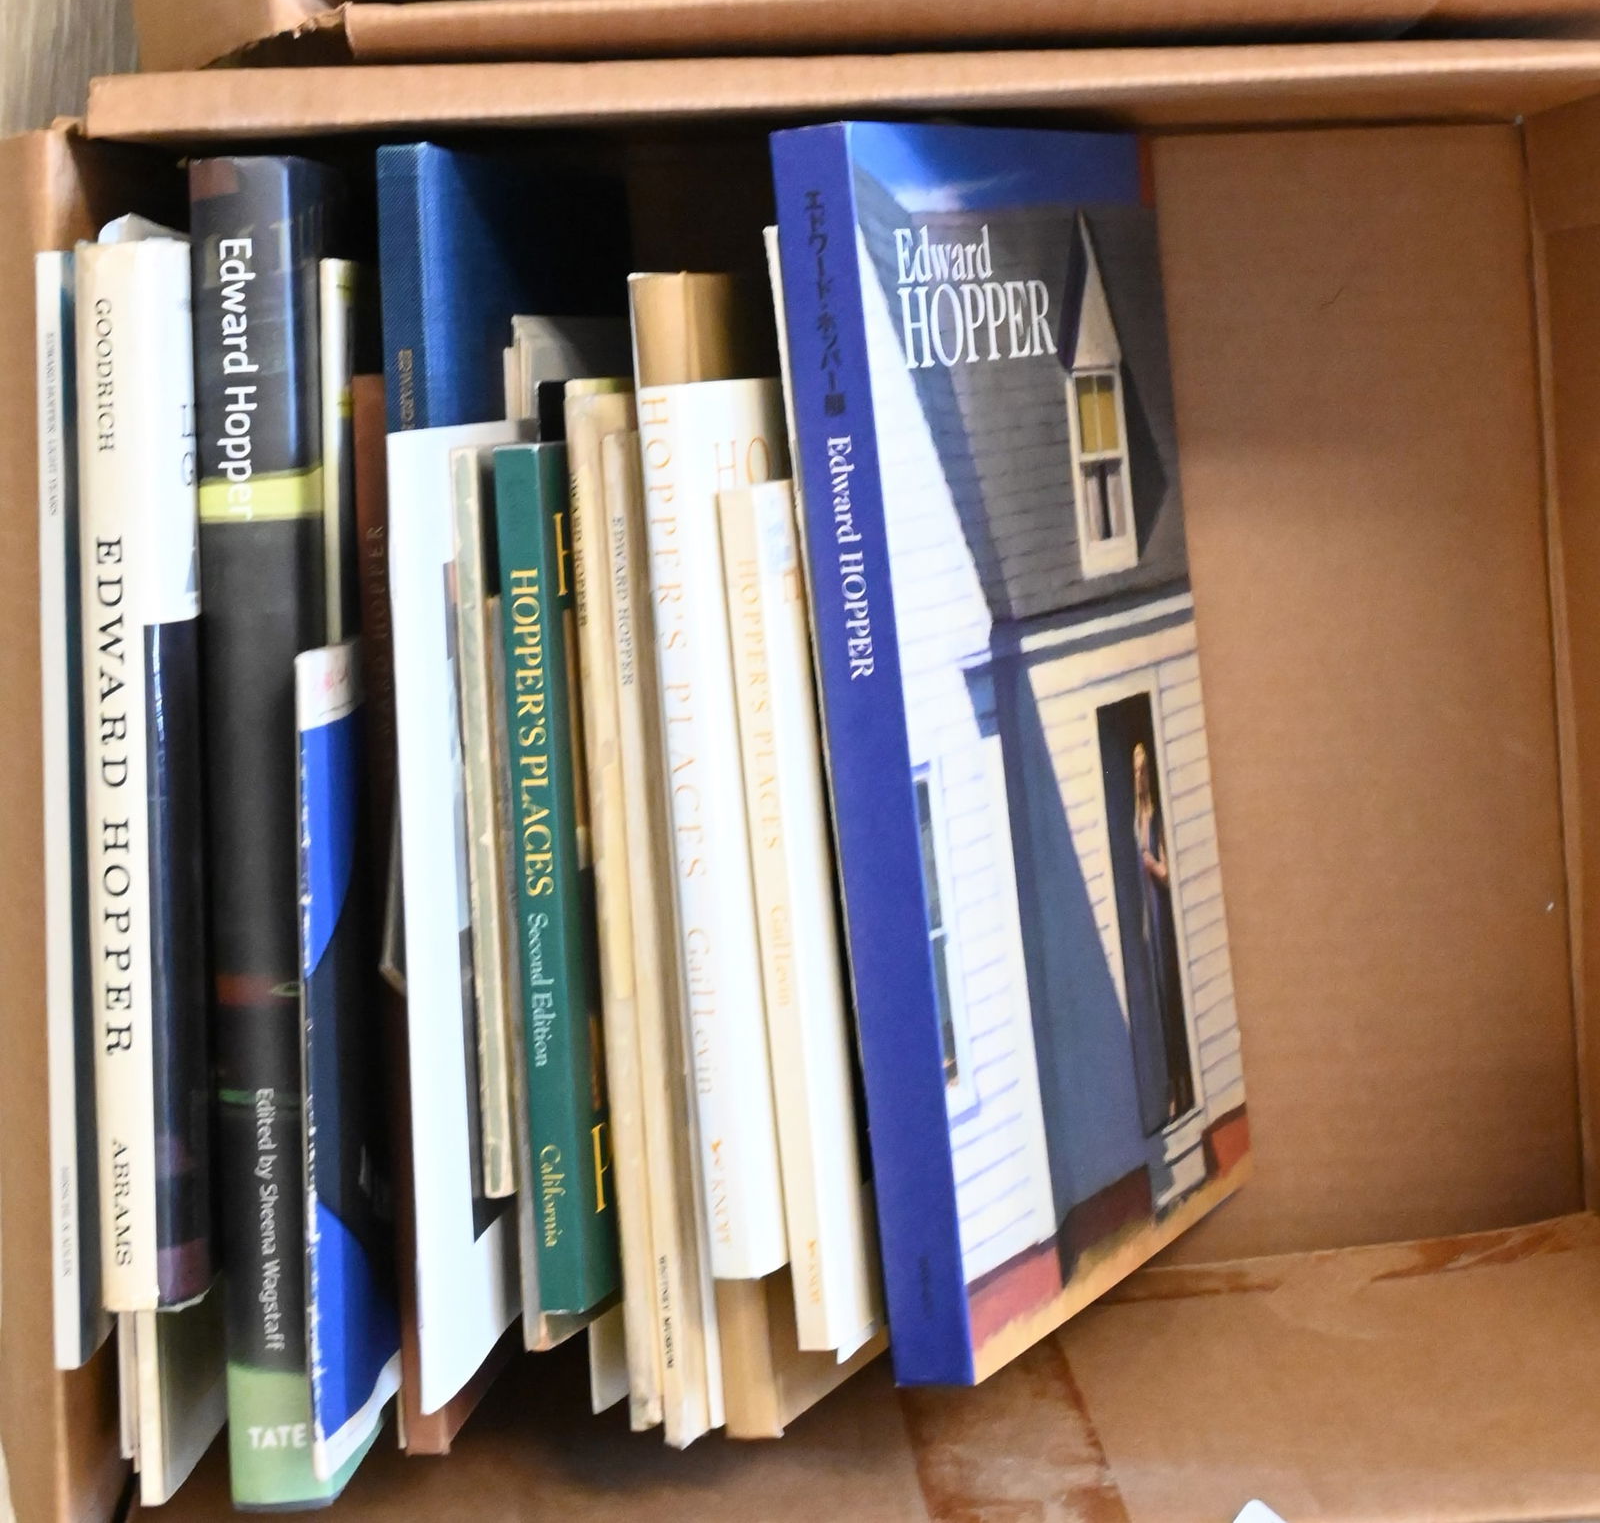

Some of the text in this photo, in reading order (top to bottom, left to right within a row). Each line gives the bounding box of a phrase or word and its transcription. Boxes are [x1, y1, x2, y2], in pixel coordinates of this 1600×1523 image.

[804, 189, 847, 418] エドワード・ホッパー展
[892, 224, 994, 284] Edward
[897, 278, 1058, 370] HOPPER
[94, 297, 115, 453] GOODRICH
[216, 237, 260, 520] Edward Hopper
[571, 548, 589, 627] HOPPER
[611, 515, 635, 686] EDWARD HOPPER
[640, 396, 708, 878] HOPPER'S PLACES
[826, 434, 875, 682] Edward HOPPER
[509, 567, 555, 898] HOPPER'S PLACES
[736, 558, 784, 850] HOPPER'S PLACES
[95, 536, 133, 1057] EDWARD HOPPER
[526, 911, 558, 1069] Second Edition
[687, 927, 716, 996] Gail
[111, 1138, 132, 1268] ABRAMS
[253, 1087, 286, 1351] Edited by Sheena Wagstaff
[538, 1143, 568, 1249] California
[247, 1423, 307, 1451] TATE
